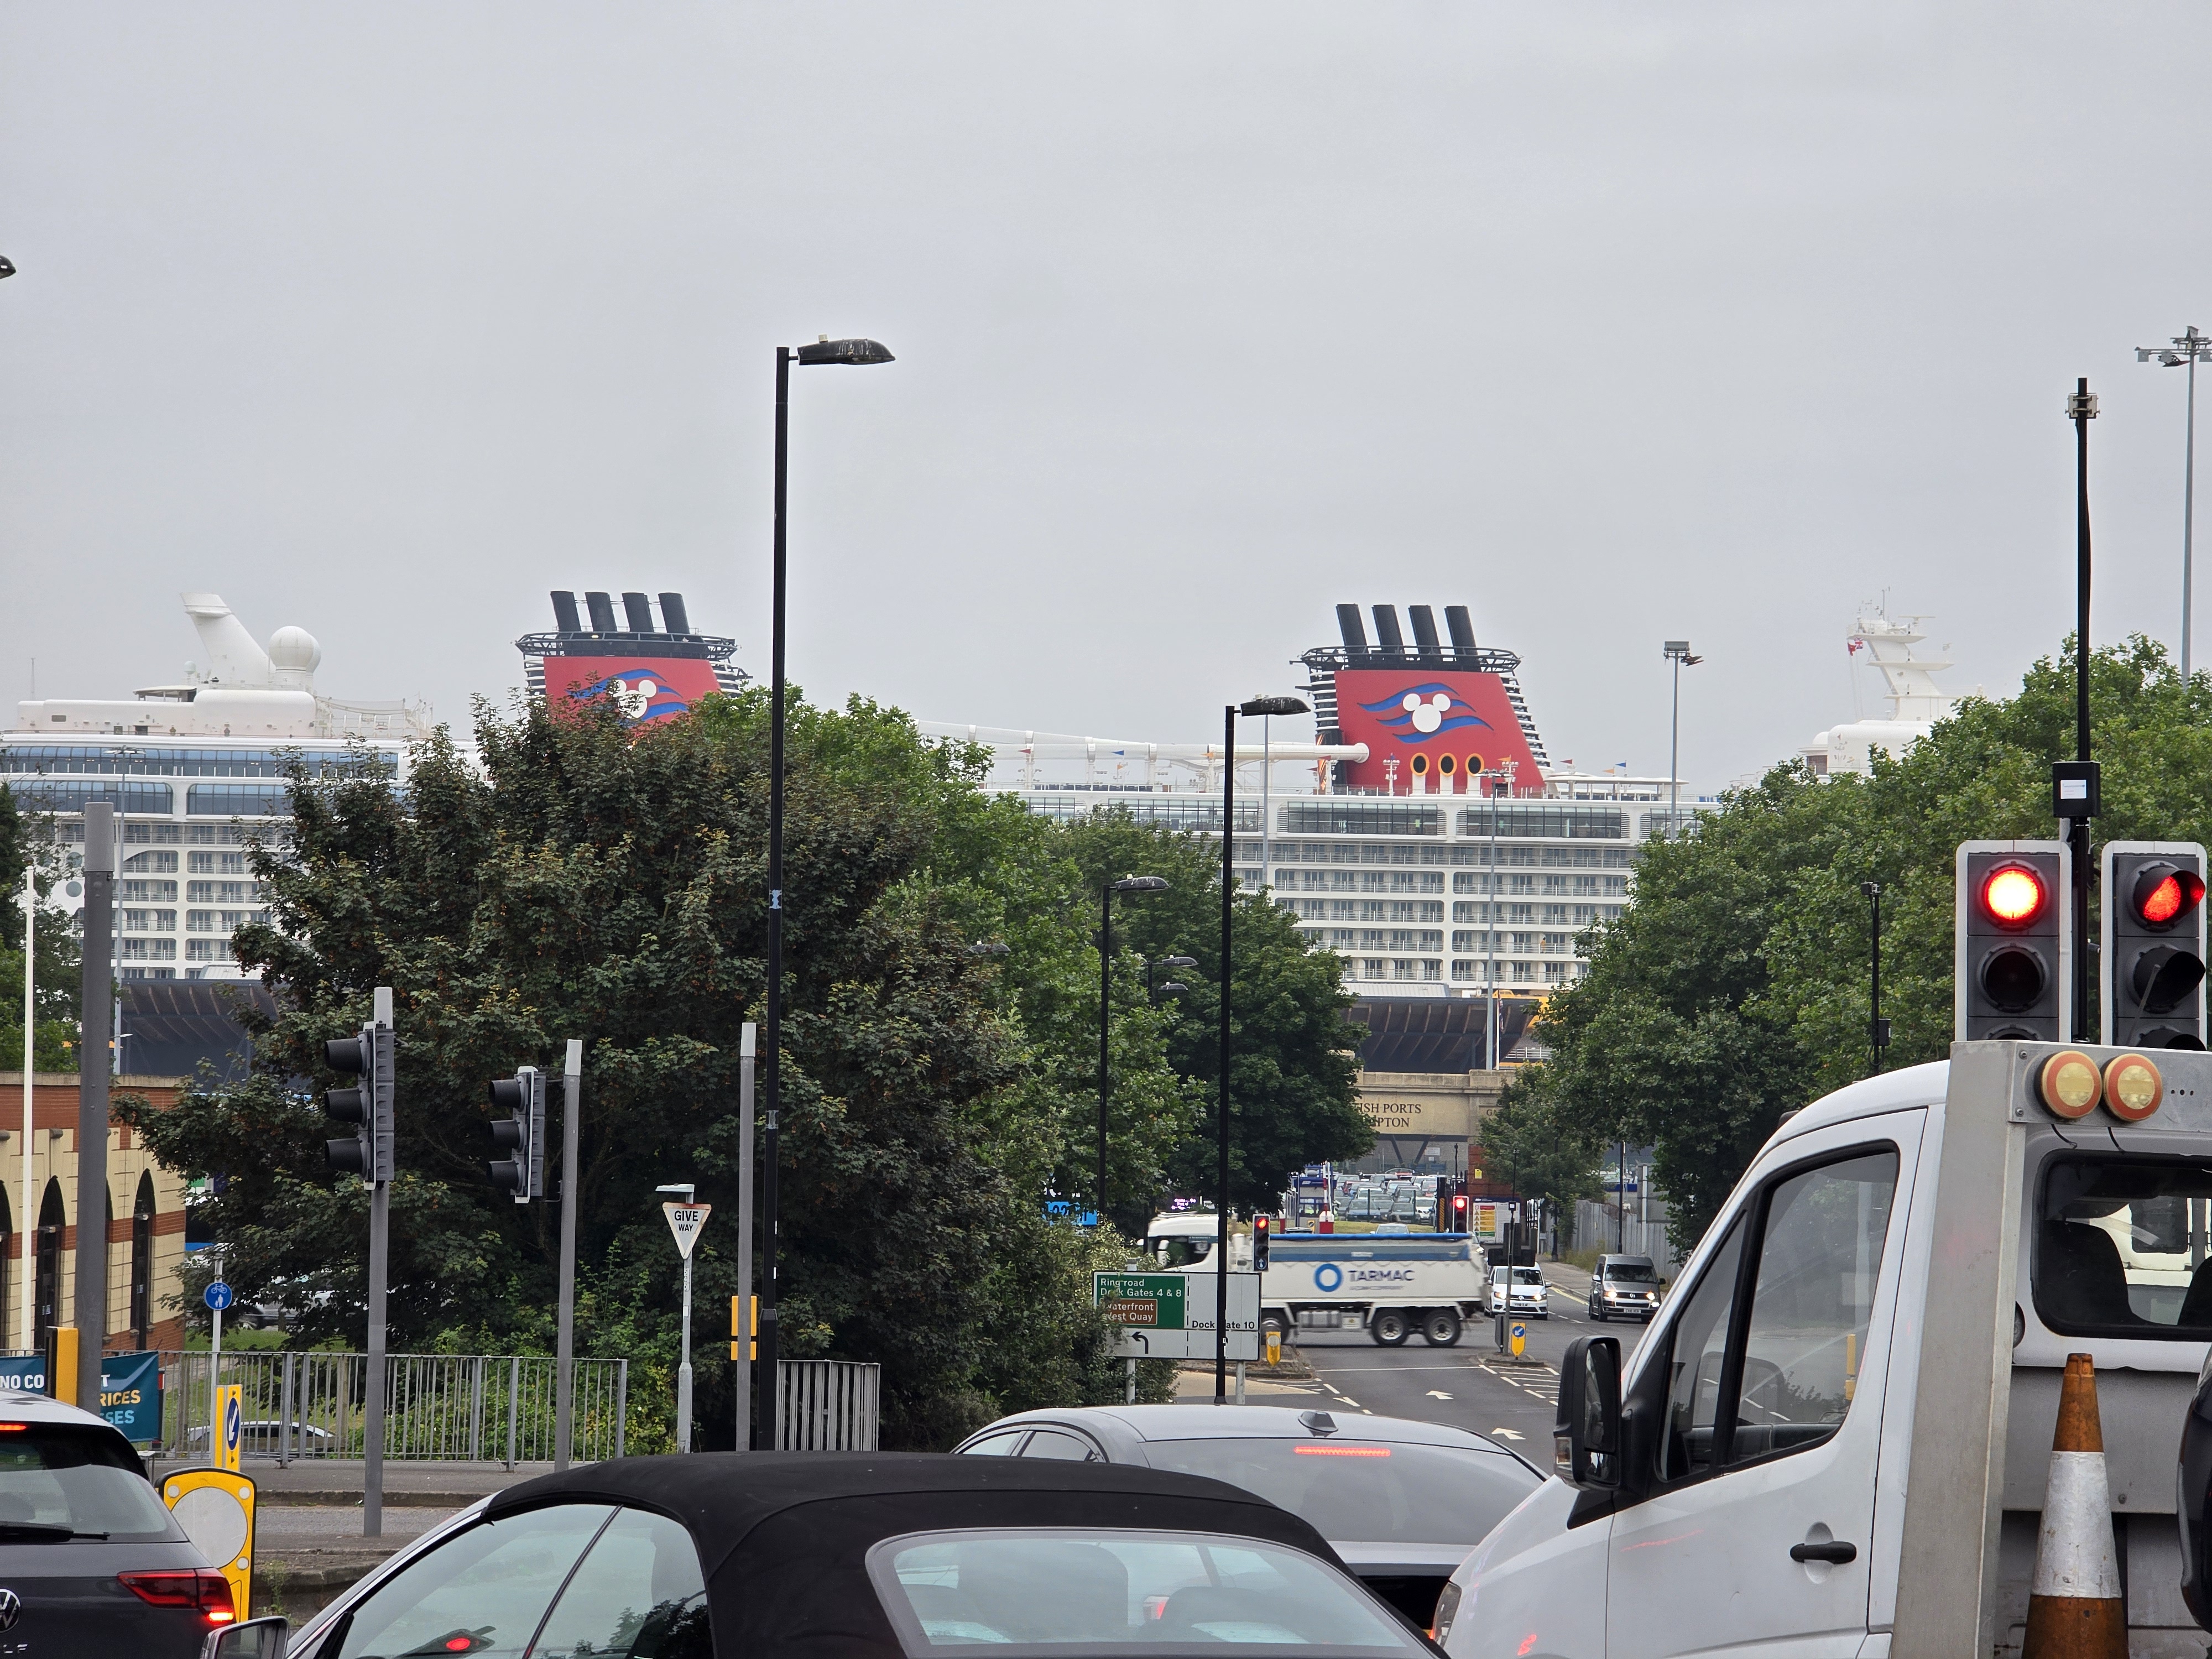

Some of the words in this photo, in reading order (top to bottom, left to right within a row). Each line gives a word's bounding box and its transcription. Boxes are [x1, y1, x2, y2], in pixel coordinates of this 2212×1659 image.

[1383, 1103, 1421, 1114] PORTS
[1375, 1117, 1410, 1127] PTON
[674, 1211, 698, 1222] GIVE
[1348, 1270, 1415, 1282] TARMAC
[1100, 1278, 1120, 1287] Ring
[1127, 1288, 1154, 1296] Gates
[1129, 1312, 1153, 1322] Quay
